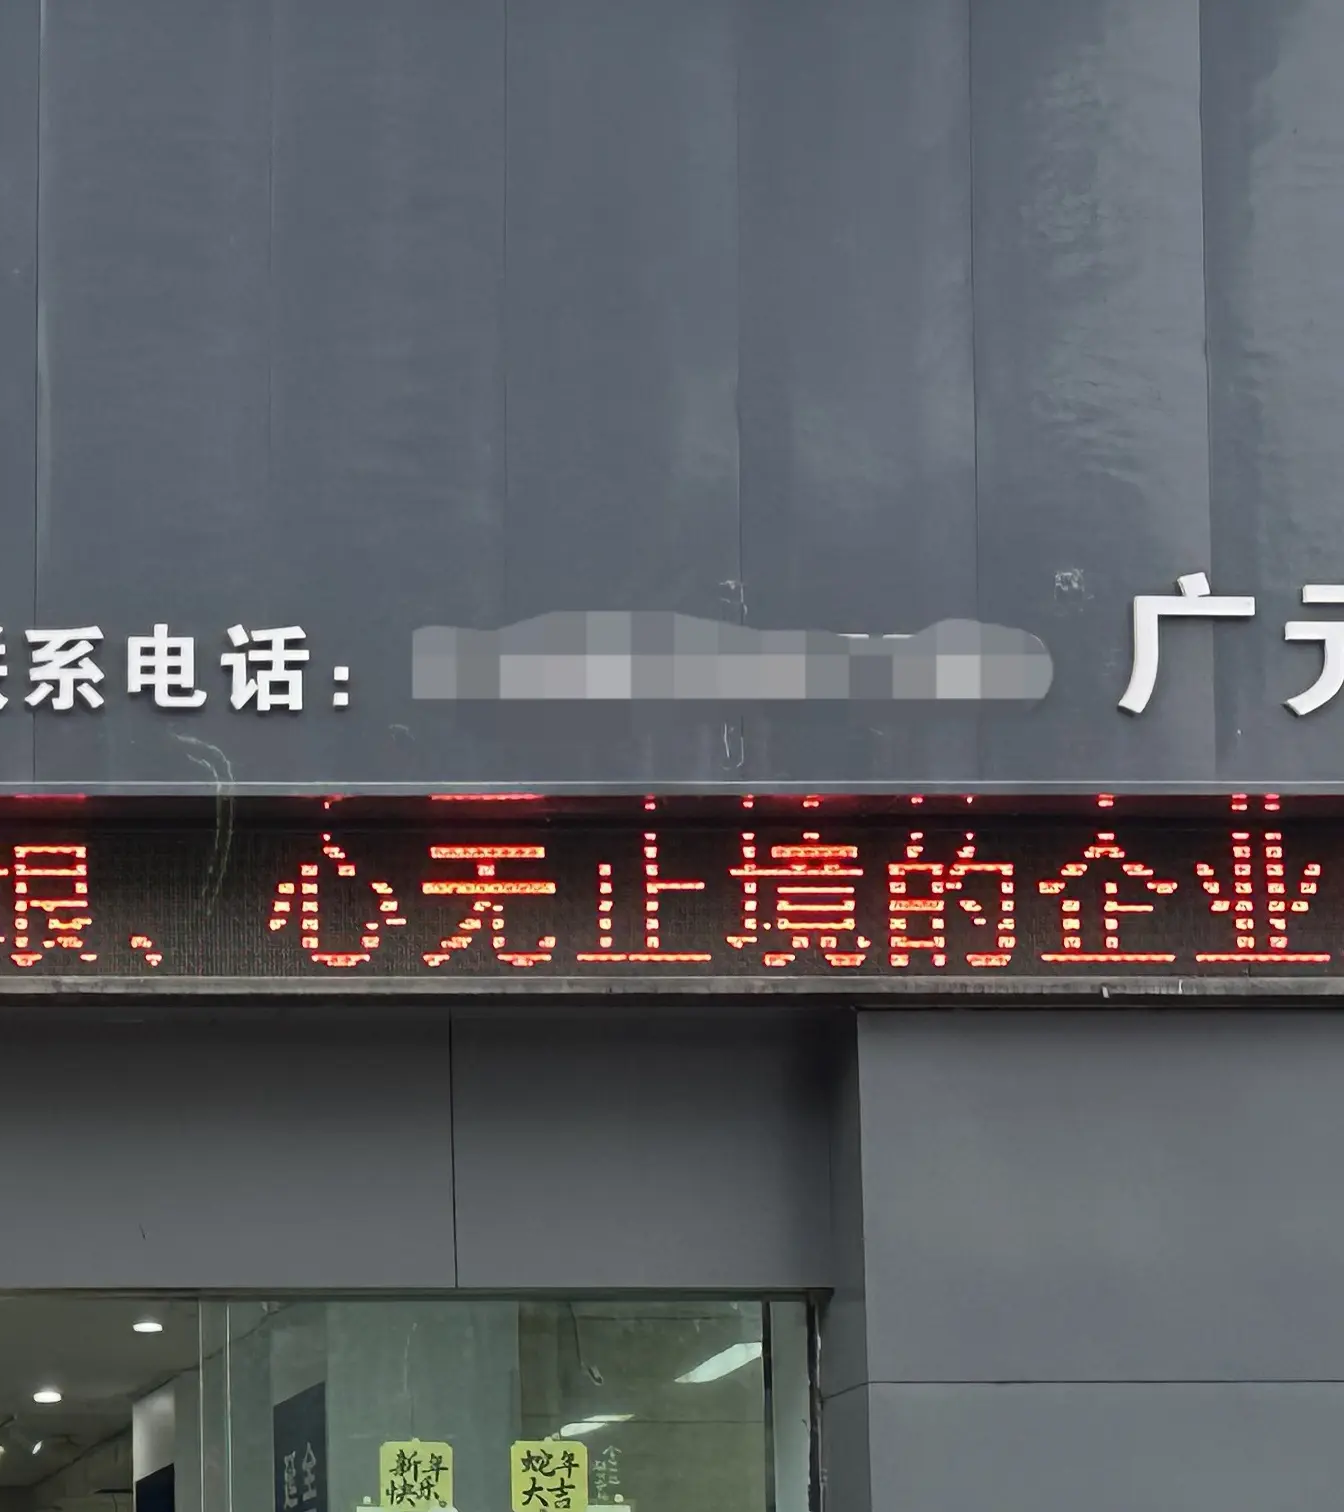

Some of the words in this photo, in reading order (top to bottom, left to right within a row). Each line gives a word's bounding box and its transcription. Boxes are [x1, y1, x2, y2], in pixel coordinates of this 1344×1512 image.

[389, 1449, 449, 1482] 新年
[520, 1449, 580, 1478] 蛇年
[386, 1476, 440, 1507] 快乐
[522, 1477, 576, 1508] 大吉
